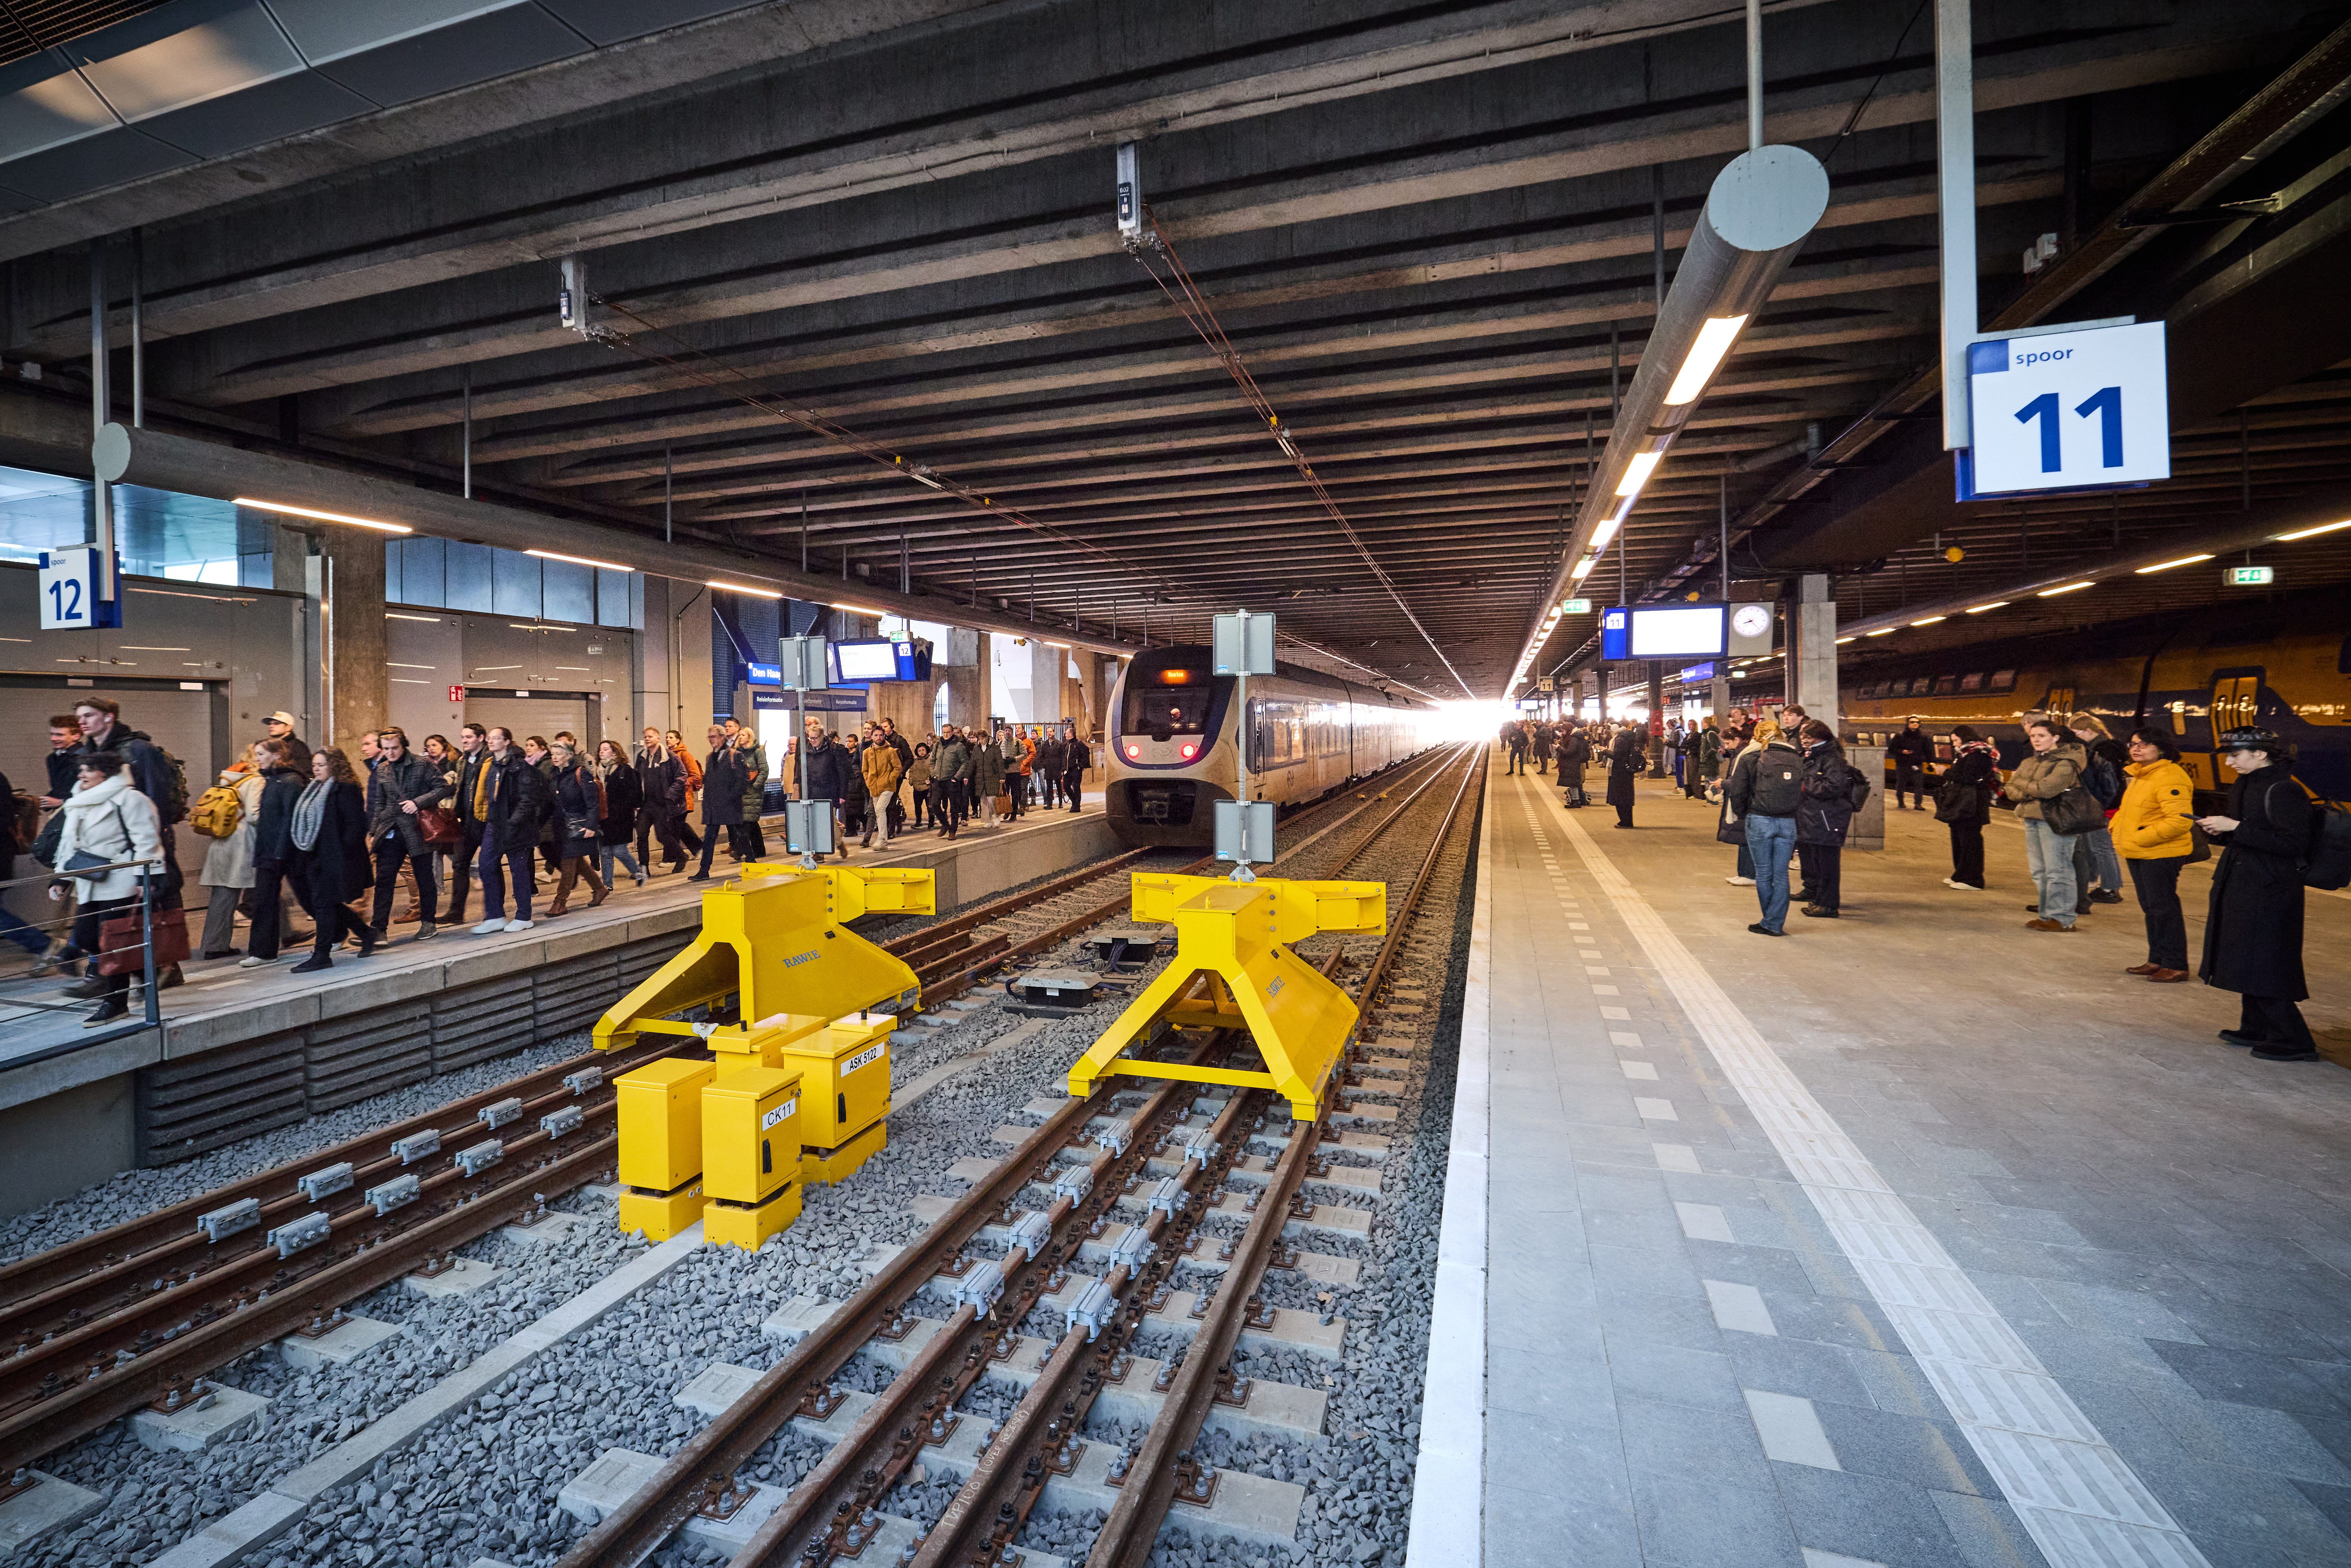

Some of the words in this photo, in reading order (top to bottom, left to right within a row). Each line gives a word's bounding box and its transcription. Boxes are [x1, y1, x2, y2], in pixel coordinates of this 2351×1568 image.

[2015, 348, 2074, 367] spoor
[2014, 386, 2124, 473] 11
[51, 558, 66, 567] spoor
[49, 579, 82, 621] 12
[753, 668, 765, 677] Den
[782, 950, 821, 968] RAWIE
[1266, 976, 1285, 998] RAWIE
[849, 1055, 862, 1071] ASK
[864, 1047, 877, 1063] 5122
[768, 1103, 790, 1126] CK11
